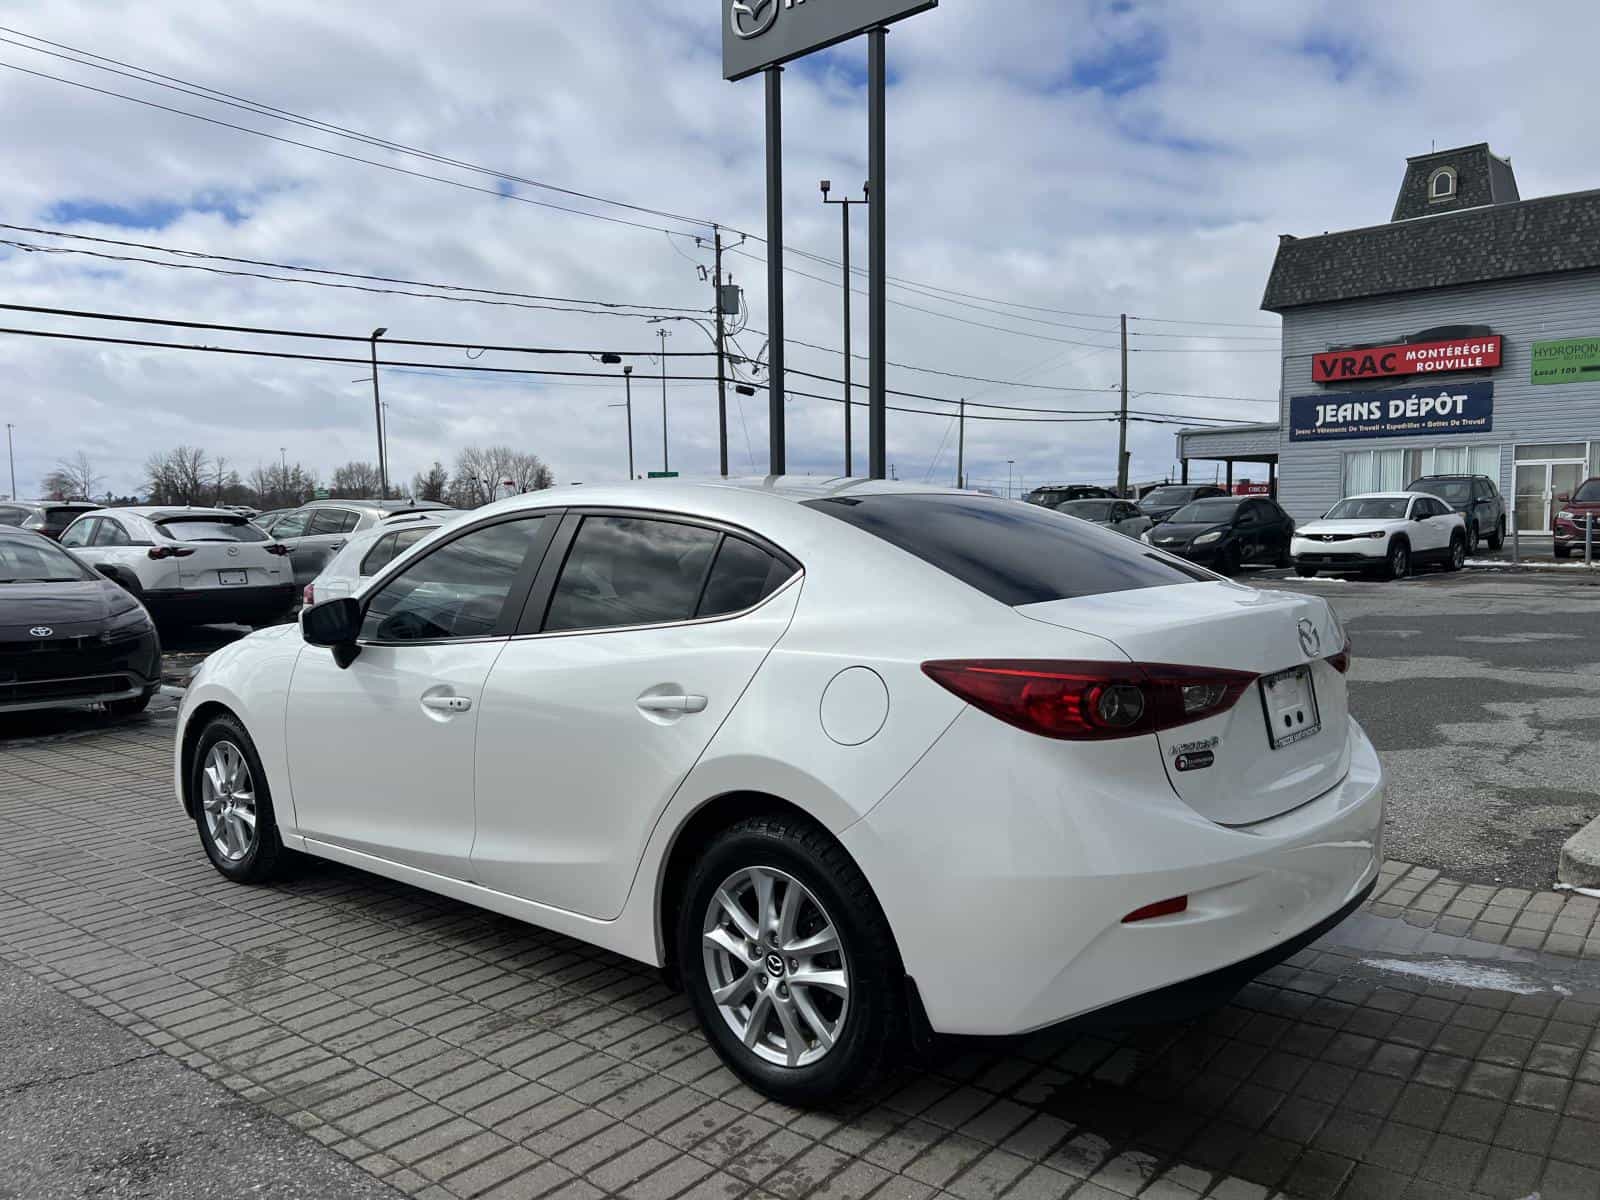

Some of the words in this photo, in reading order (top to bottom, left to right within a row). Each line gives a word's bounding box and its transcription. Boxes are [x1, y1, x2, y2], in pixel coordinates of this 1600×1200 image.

[1405, 343, 1495, 361] MONTÉRÉGIE
[1320, 352, 1397, 378] VRAC
[1416, 357, 1483, 373] ROUVILLE
[1315, 400, 1382, 427] JEANS
[1388, 392, 1468, 418] DÉPÔT
